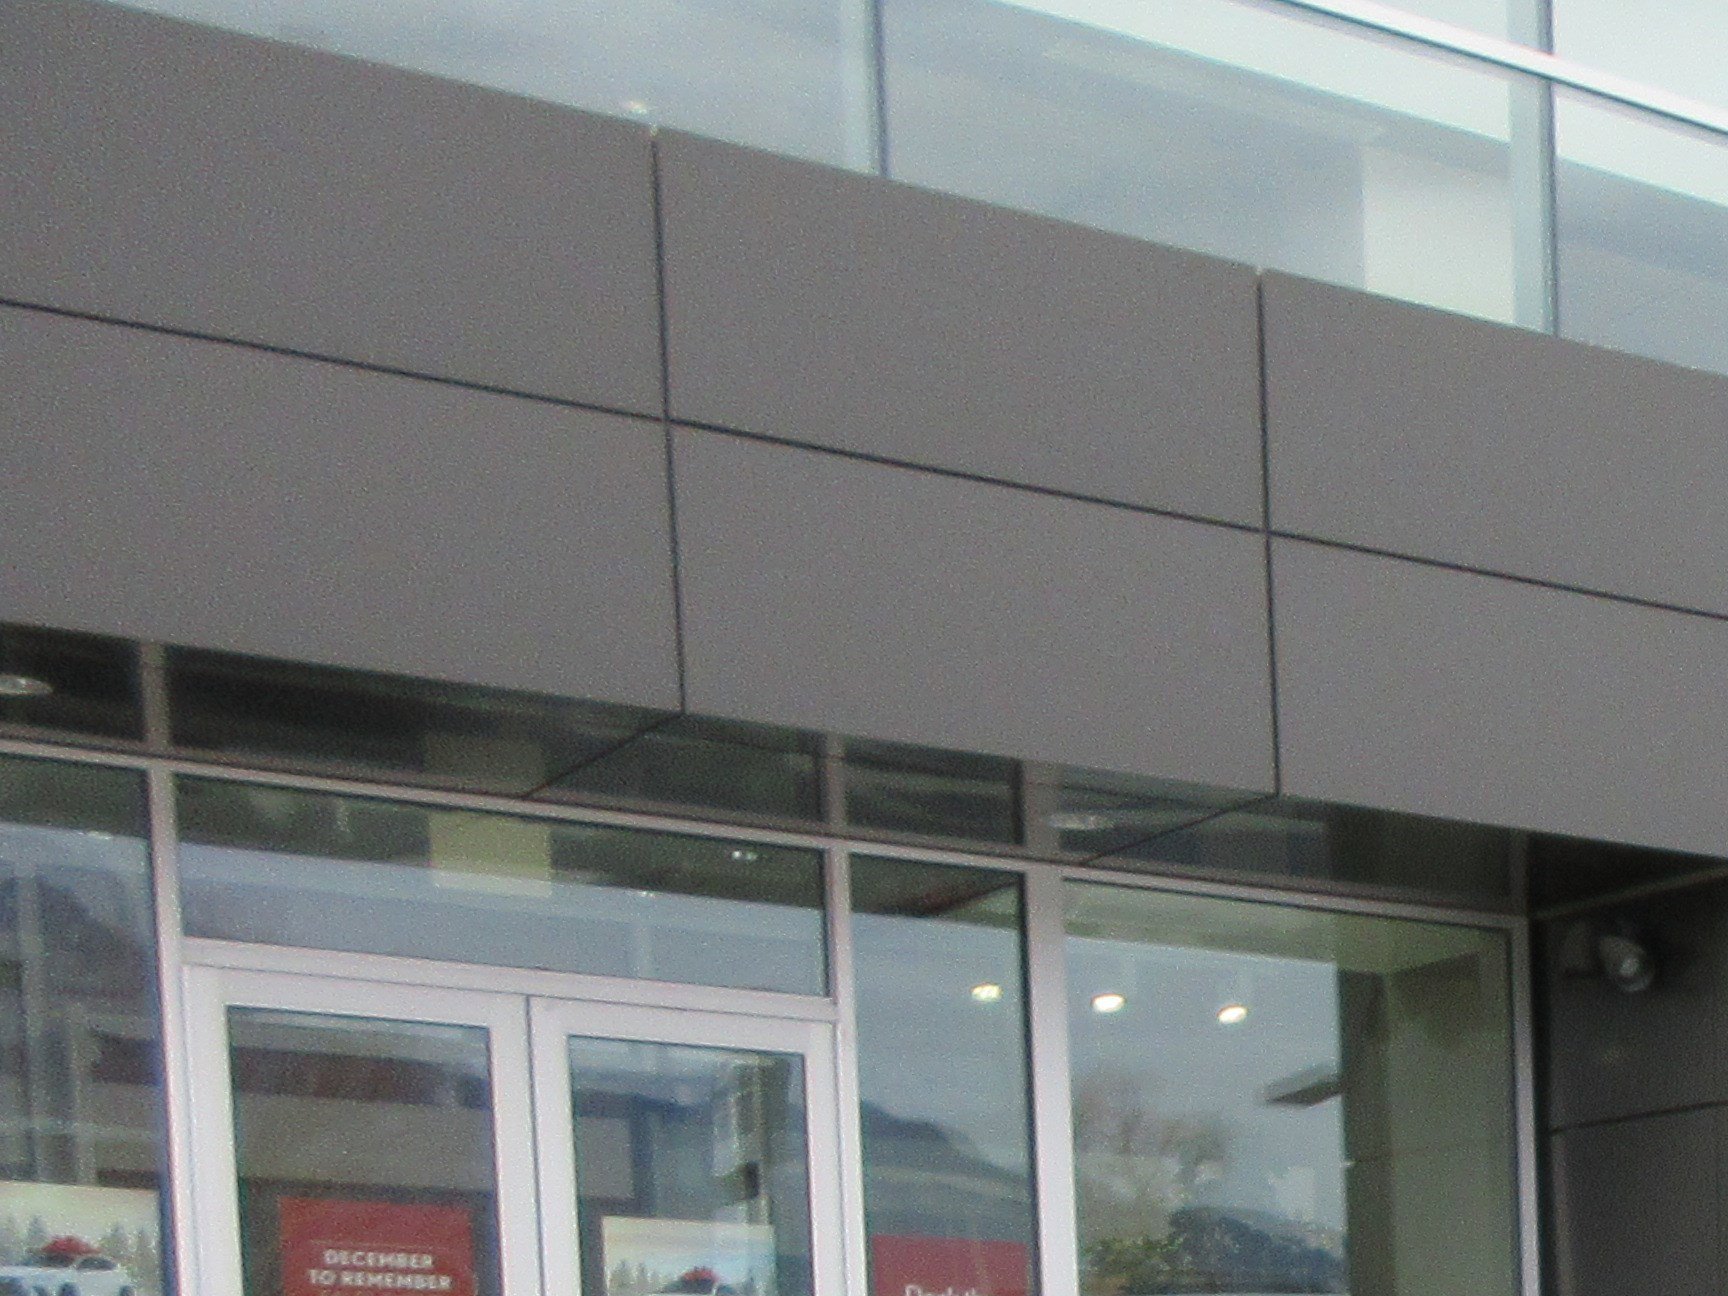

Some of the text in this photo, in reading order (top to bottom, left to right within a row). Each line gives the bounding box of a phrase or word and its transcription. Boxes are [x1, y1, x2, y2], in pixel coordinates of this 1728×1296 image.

[323, 1249, 433, 1268] DECEMBER
[309, 1269, 451, 1289] TO REMEMBER
